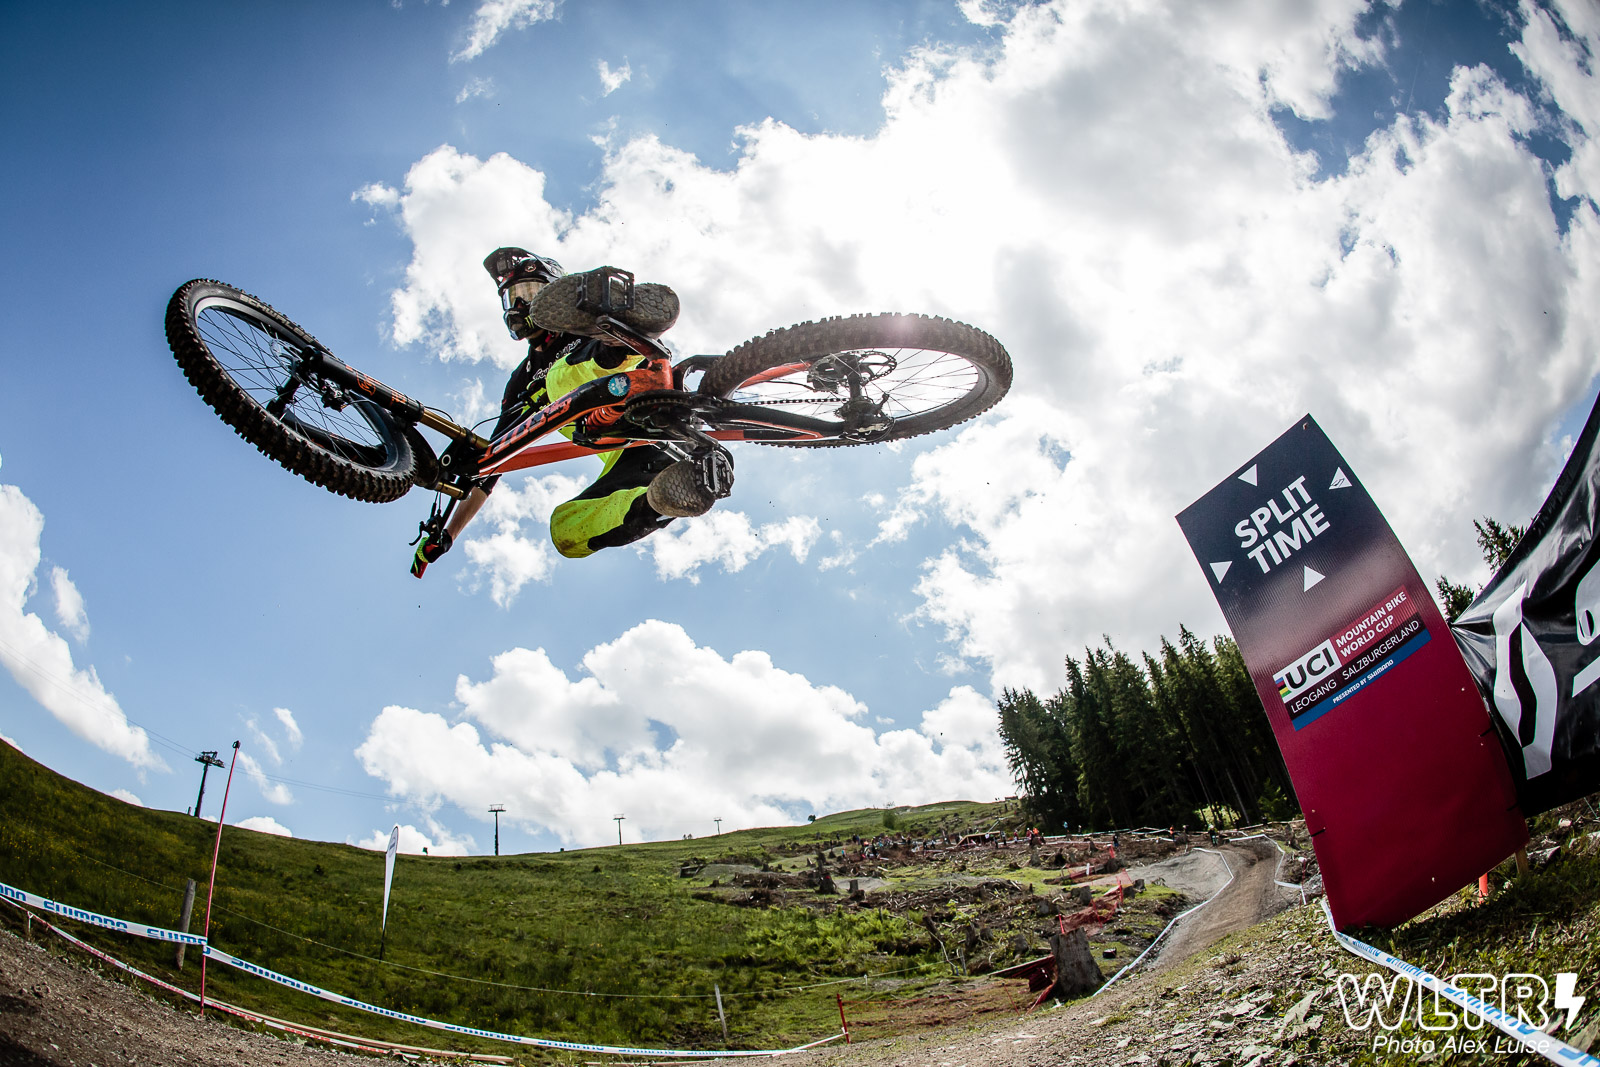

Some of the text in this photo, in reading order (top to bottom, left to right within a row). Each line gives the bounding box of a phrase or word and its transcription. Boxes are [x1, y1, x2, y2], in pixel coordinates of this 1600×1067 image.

[1234, 475, 1313, 549] SPLIT
[1247, 504, 1331, 574] TIME
[1336, 592, 1407, 648] MOUNTAIN BIKE
[1340, 615, 1394, 658] WORLD CUP
[1285, 647, 1335, 689] UCI
[1291, 620, 1420, 713] LEOGANG SALZBURGERLAND
[1332, 682, 1360, 704] PRESENTED
[1359, 677, 1367, 686] BY
